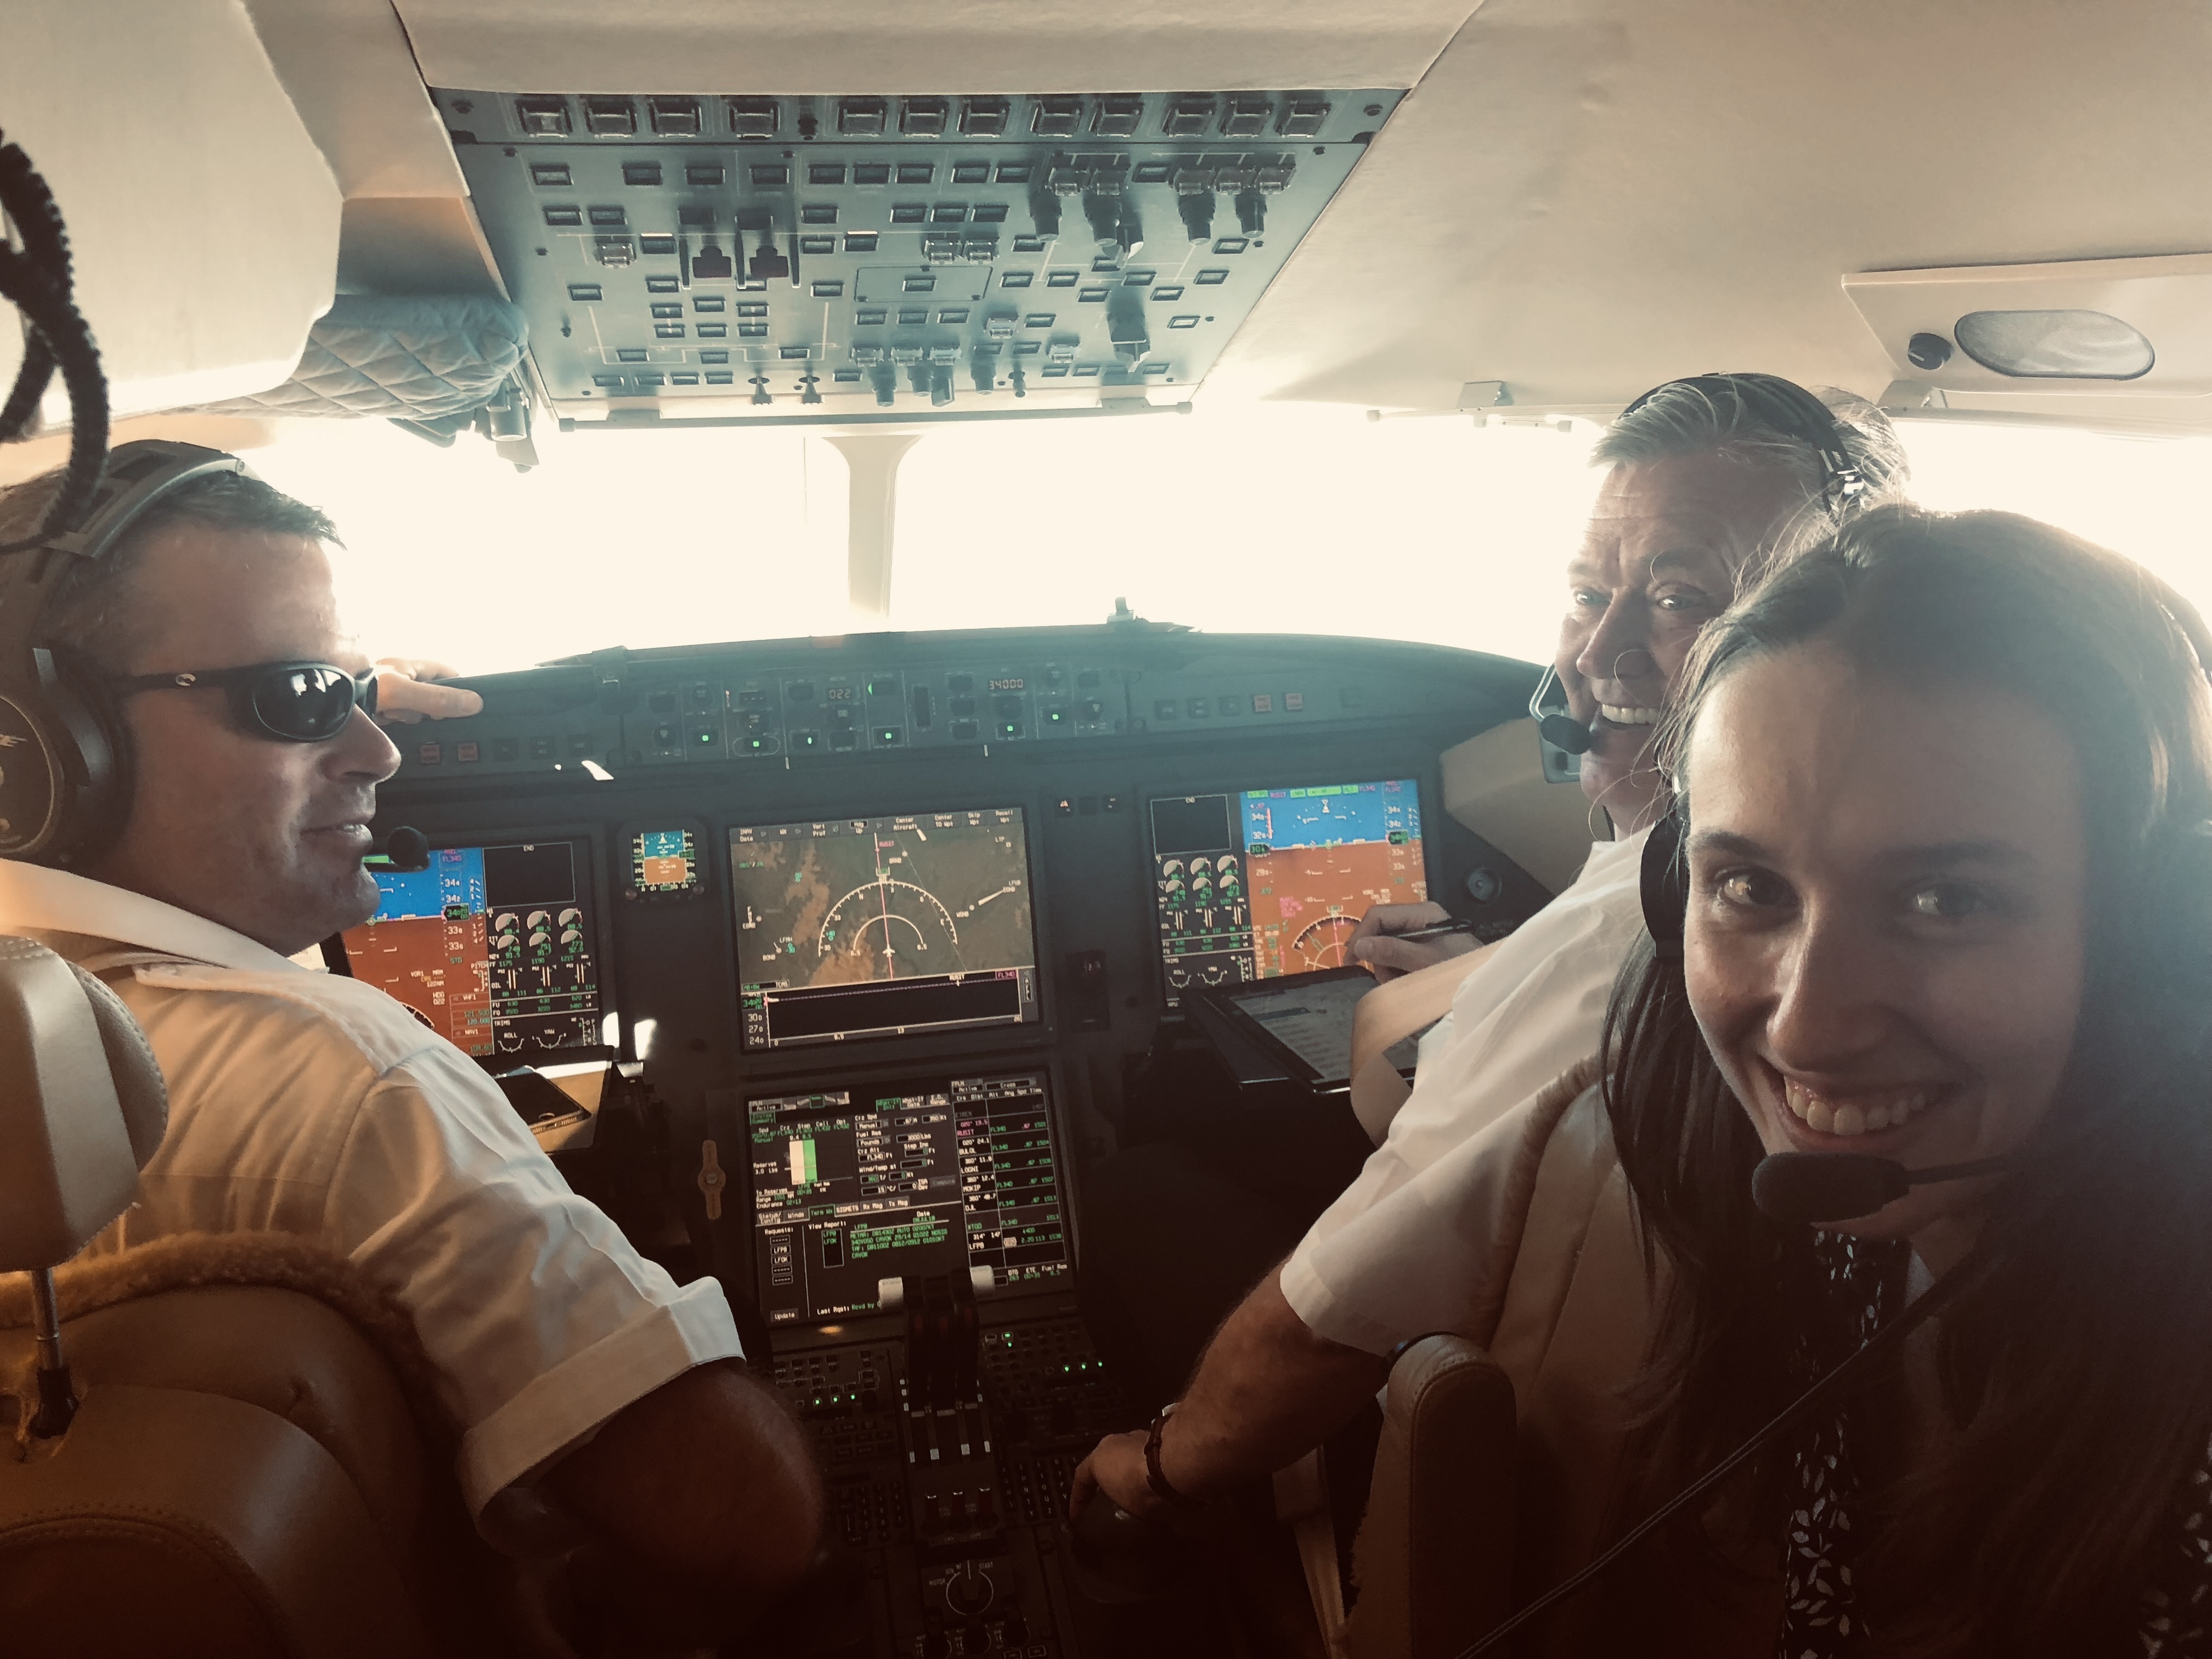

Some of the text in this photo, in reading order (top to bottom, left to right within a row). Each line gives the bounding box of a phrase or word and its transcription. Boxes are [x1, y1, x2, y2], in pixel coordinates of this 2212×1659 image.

[989, 679, 1023, 690] 34000
[828, 688, 851, 699] 022
[859, 1165, 888, 1173] Wind/Temp
[963, 1184, 981, 1193] MOKIP
[836, 1205, 859, 1214] SIGMETS
[775, 1312, 795, 1321] Update
[978, 1561, 994, 1570] START
[929, 1578, 945, 1586] MOTOR
